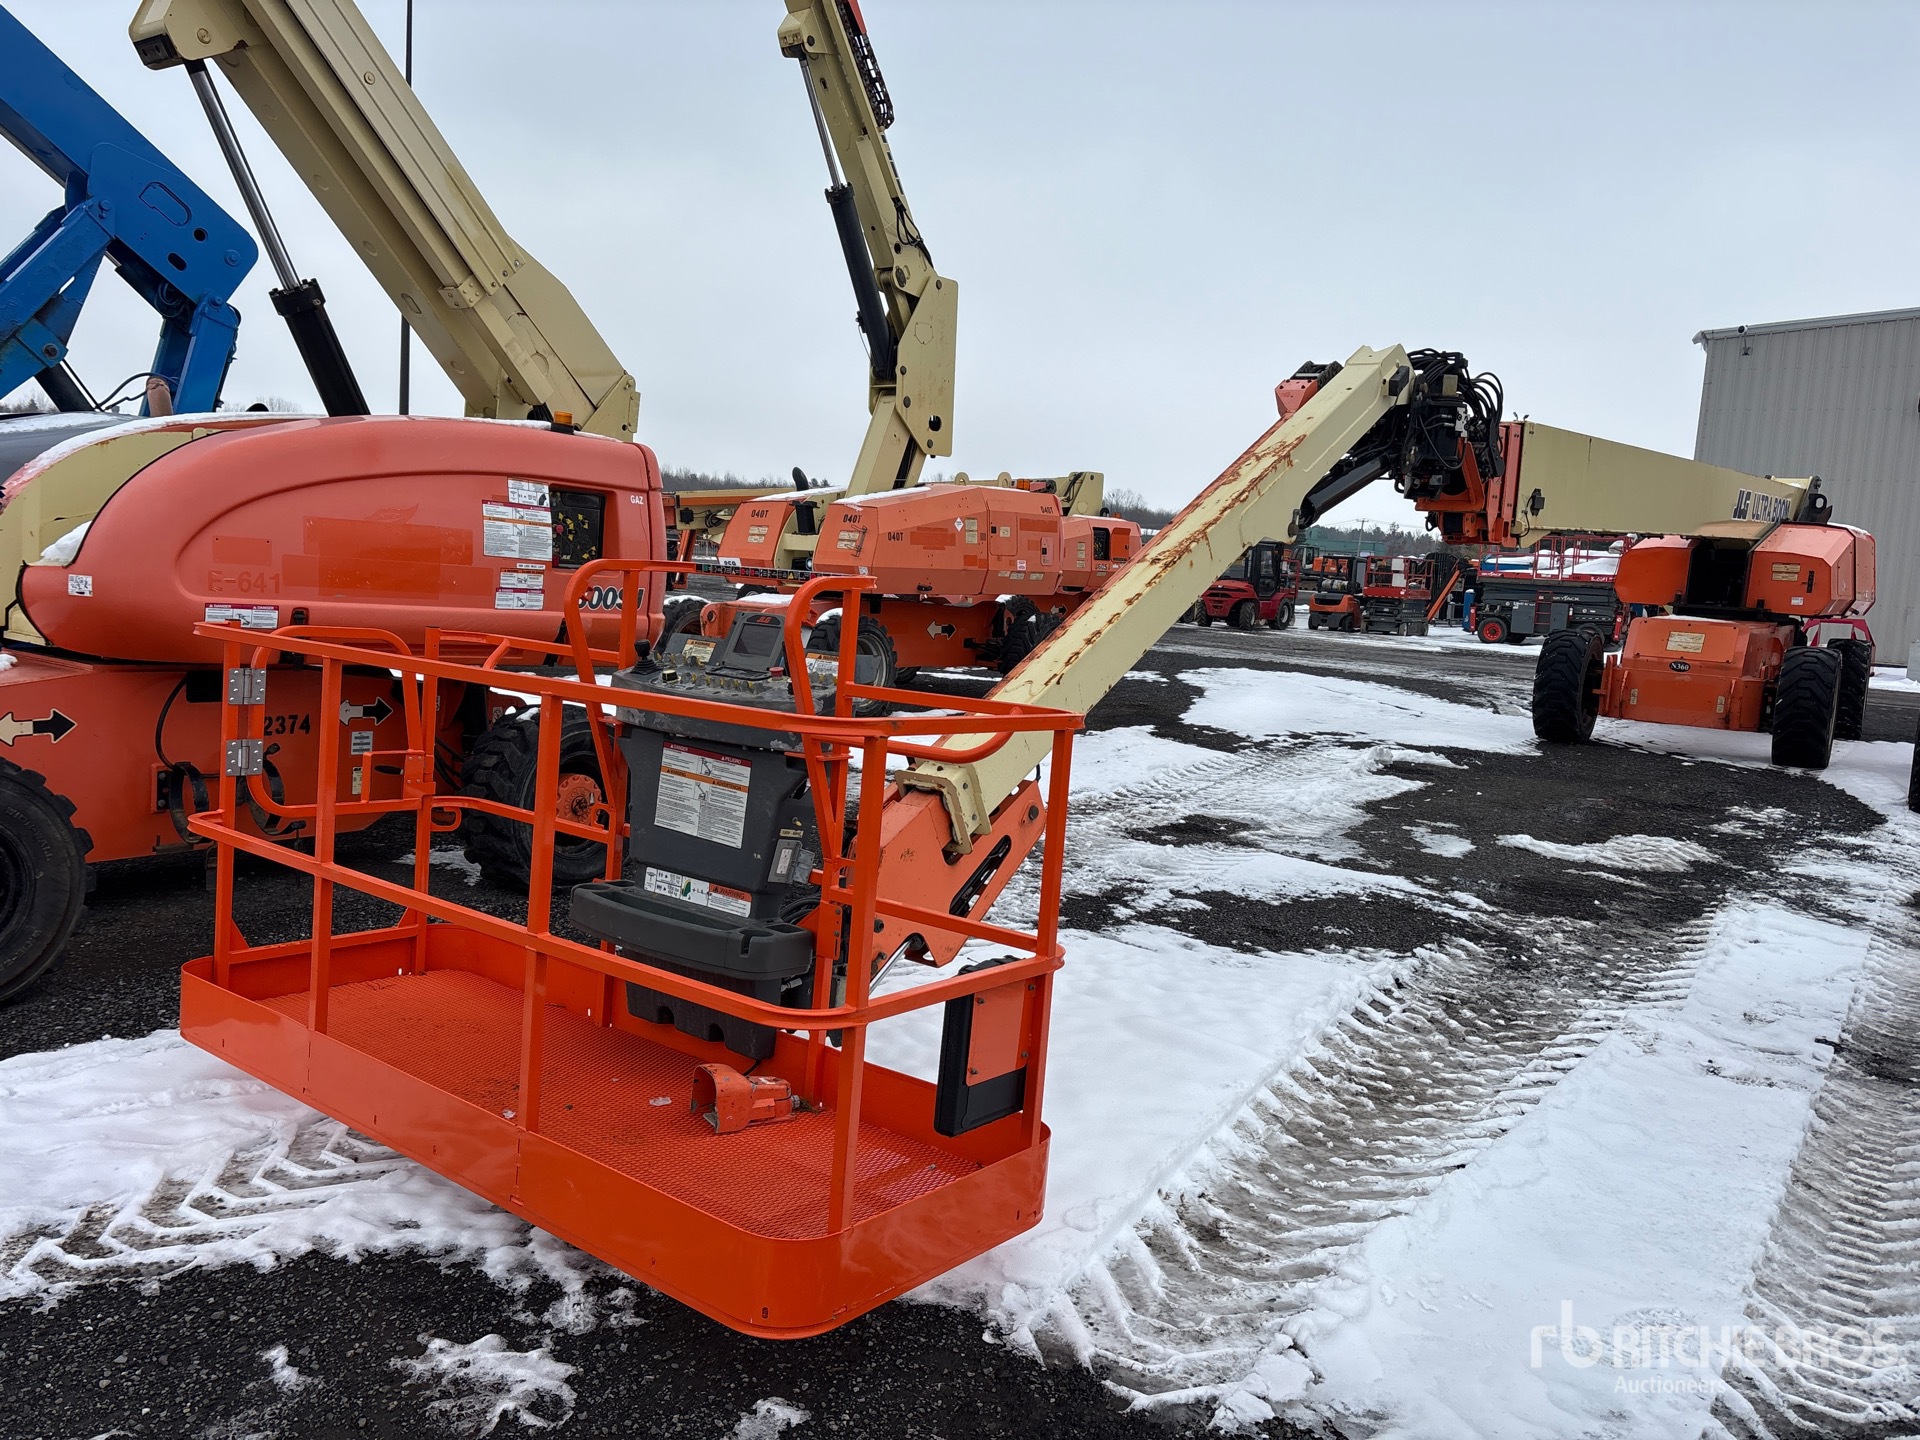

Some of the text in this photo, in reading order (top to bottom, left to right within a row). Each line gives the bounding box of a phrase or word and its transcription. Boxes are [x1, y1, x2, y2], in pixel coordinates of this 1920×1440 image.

[630, 494, 644, 505] GAZ
[1731, 488, 1752, 521] JLG
[1752, 491, 1772, 523] ULTRA
[756, 616, 772, 624] JLG
[1670, 662, 1689, 671] N360
[264, 714, 311, 736] 2374
[673, 744, 689, 752] DANGER
[670, 768, 687, 778] WARNING
[720, 887, 745, 900] WARNING
